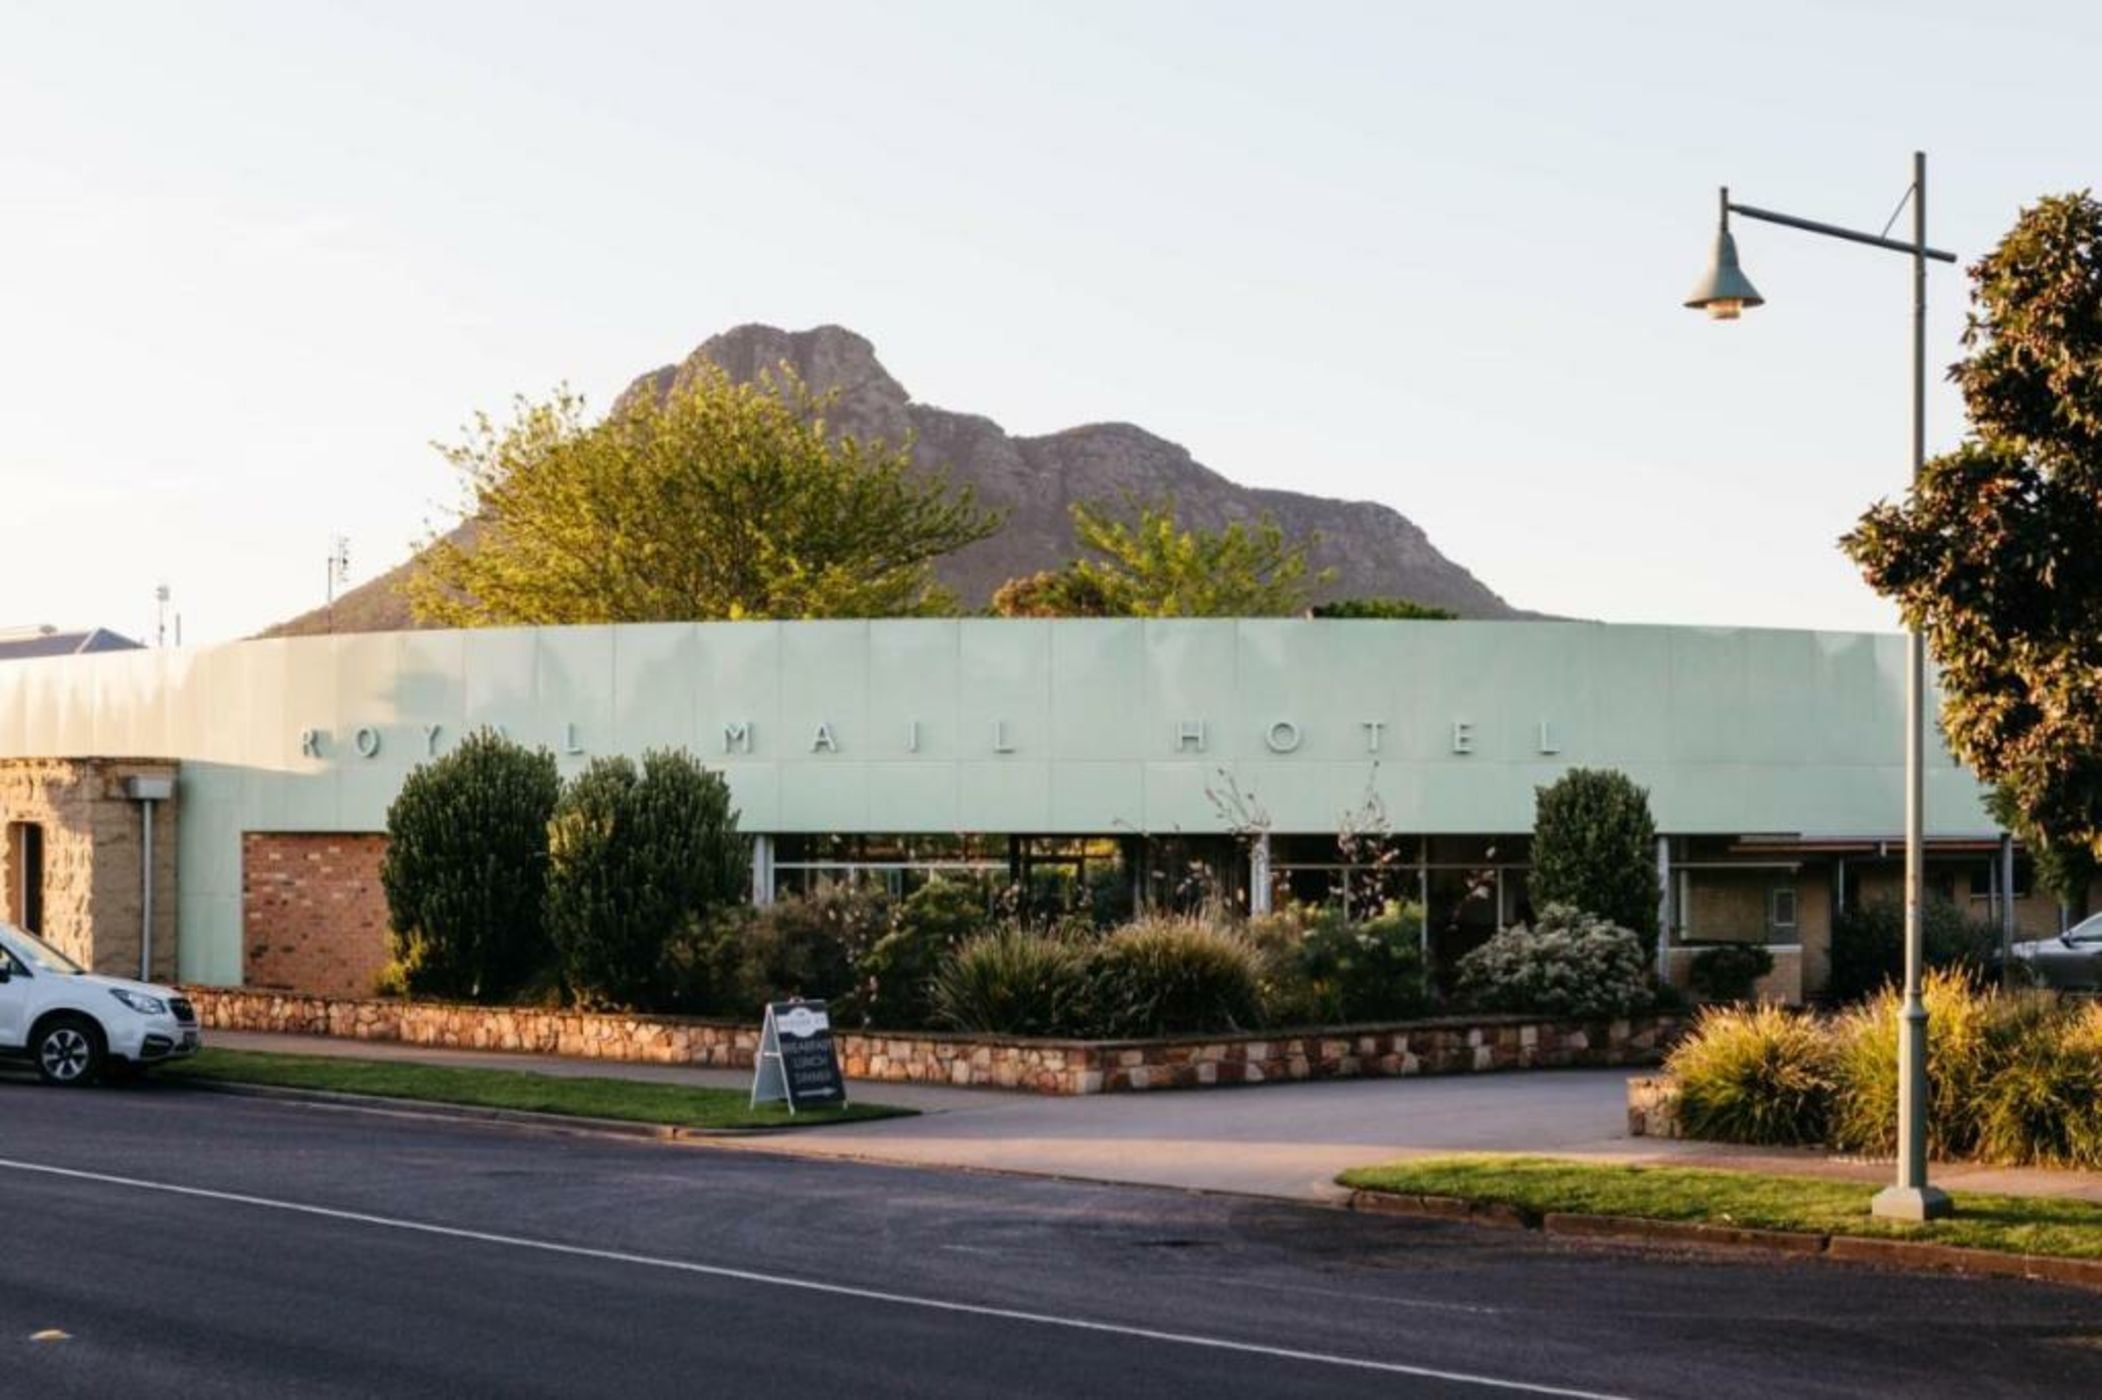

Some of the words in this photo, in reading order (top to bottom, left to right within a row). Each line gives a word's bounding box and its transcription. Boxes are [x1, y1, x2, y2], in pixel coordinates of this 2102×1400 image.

[299, 722, 585, 758] ROYL
[722, 721, 1017, 755] MAIL
[1176, 720, 1561, 756] HOTEL
